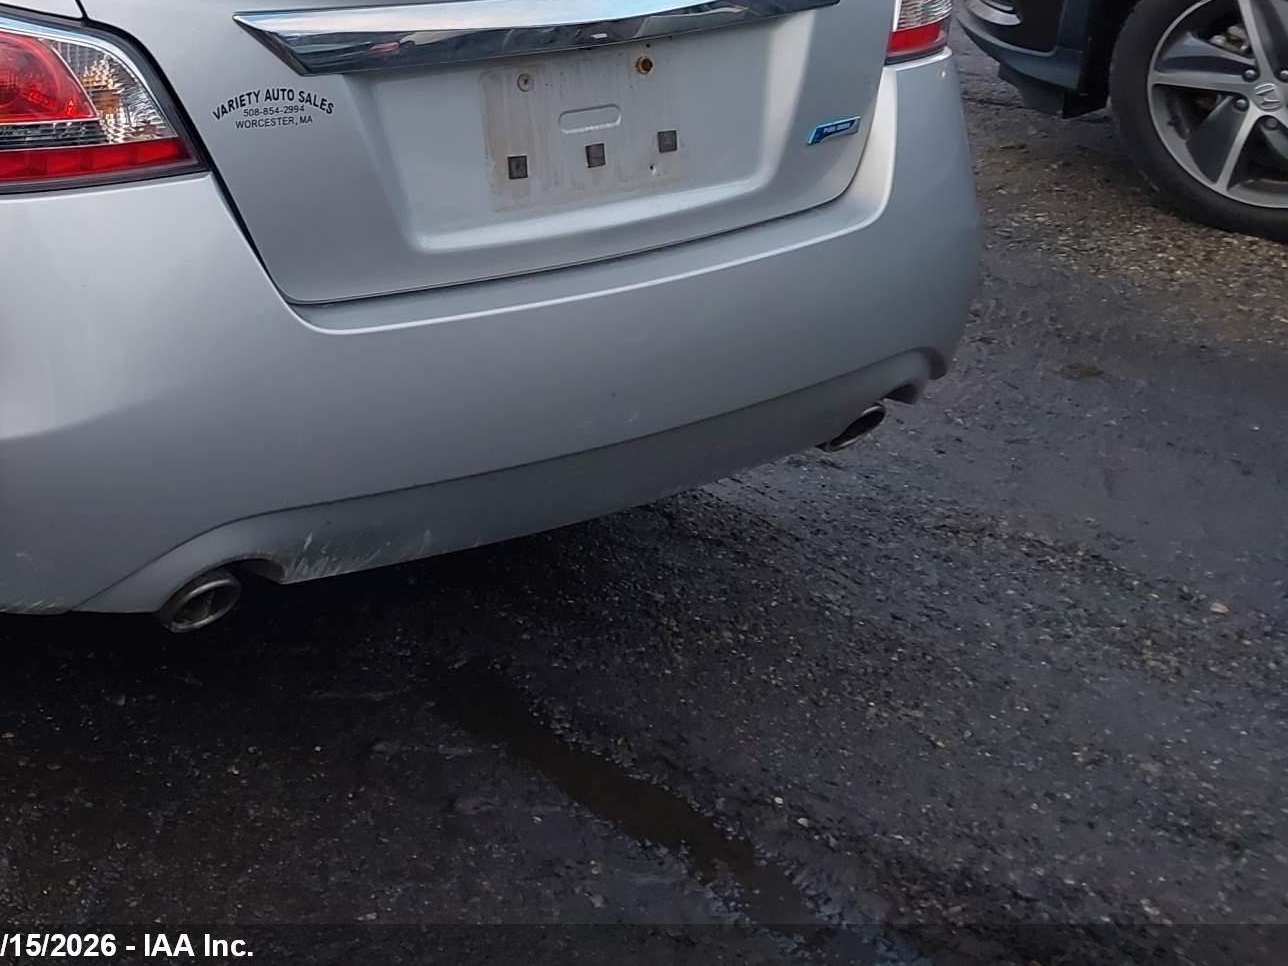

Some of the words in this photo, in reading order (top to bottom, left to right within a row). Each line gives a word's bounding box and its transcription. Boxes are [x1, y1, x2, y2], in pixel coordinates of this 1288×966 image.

[212, 89, 261, 121] VARIETY
[264, 88, 295, 102] AUTO
[298, 90, 334, 115] SALES
[243, 104, 305, 117] 508-854-2994
[235, 116, 298, 130] WORCESTER,
[299, 114, 313, 124] MA
